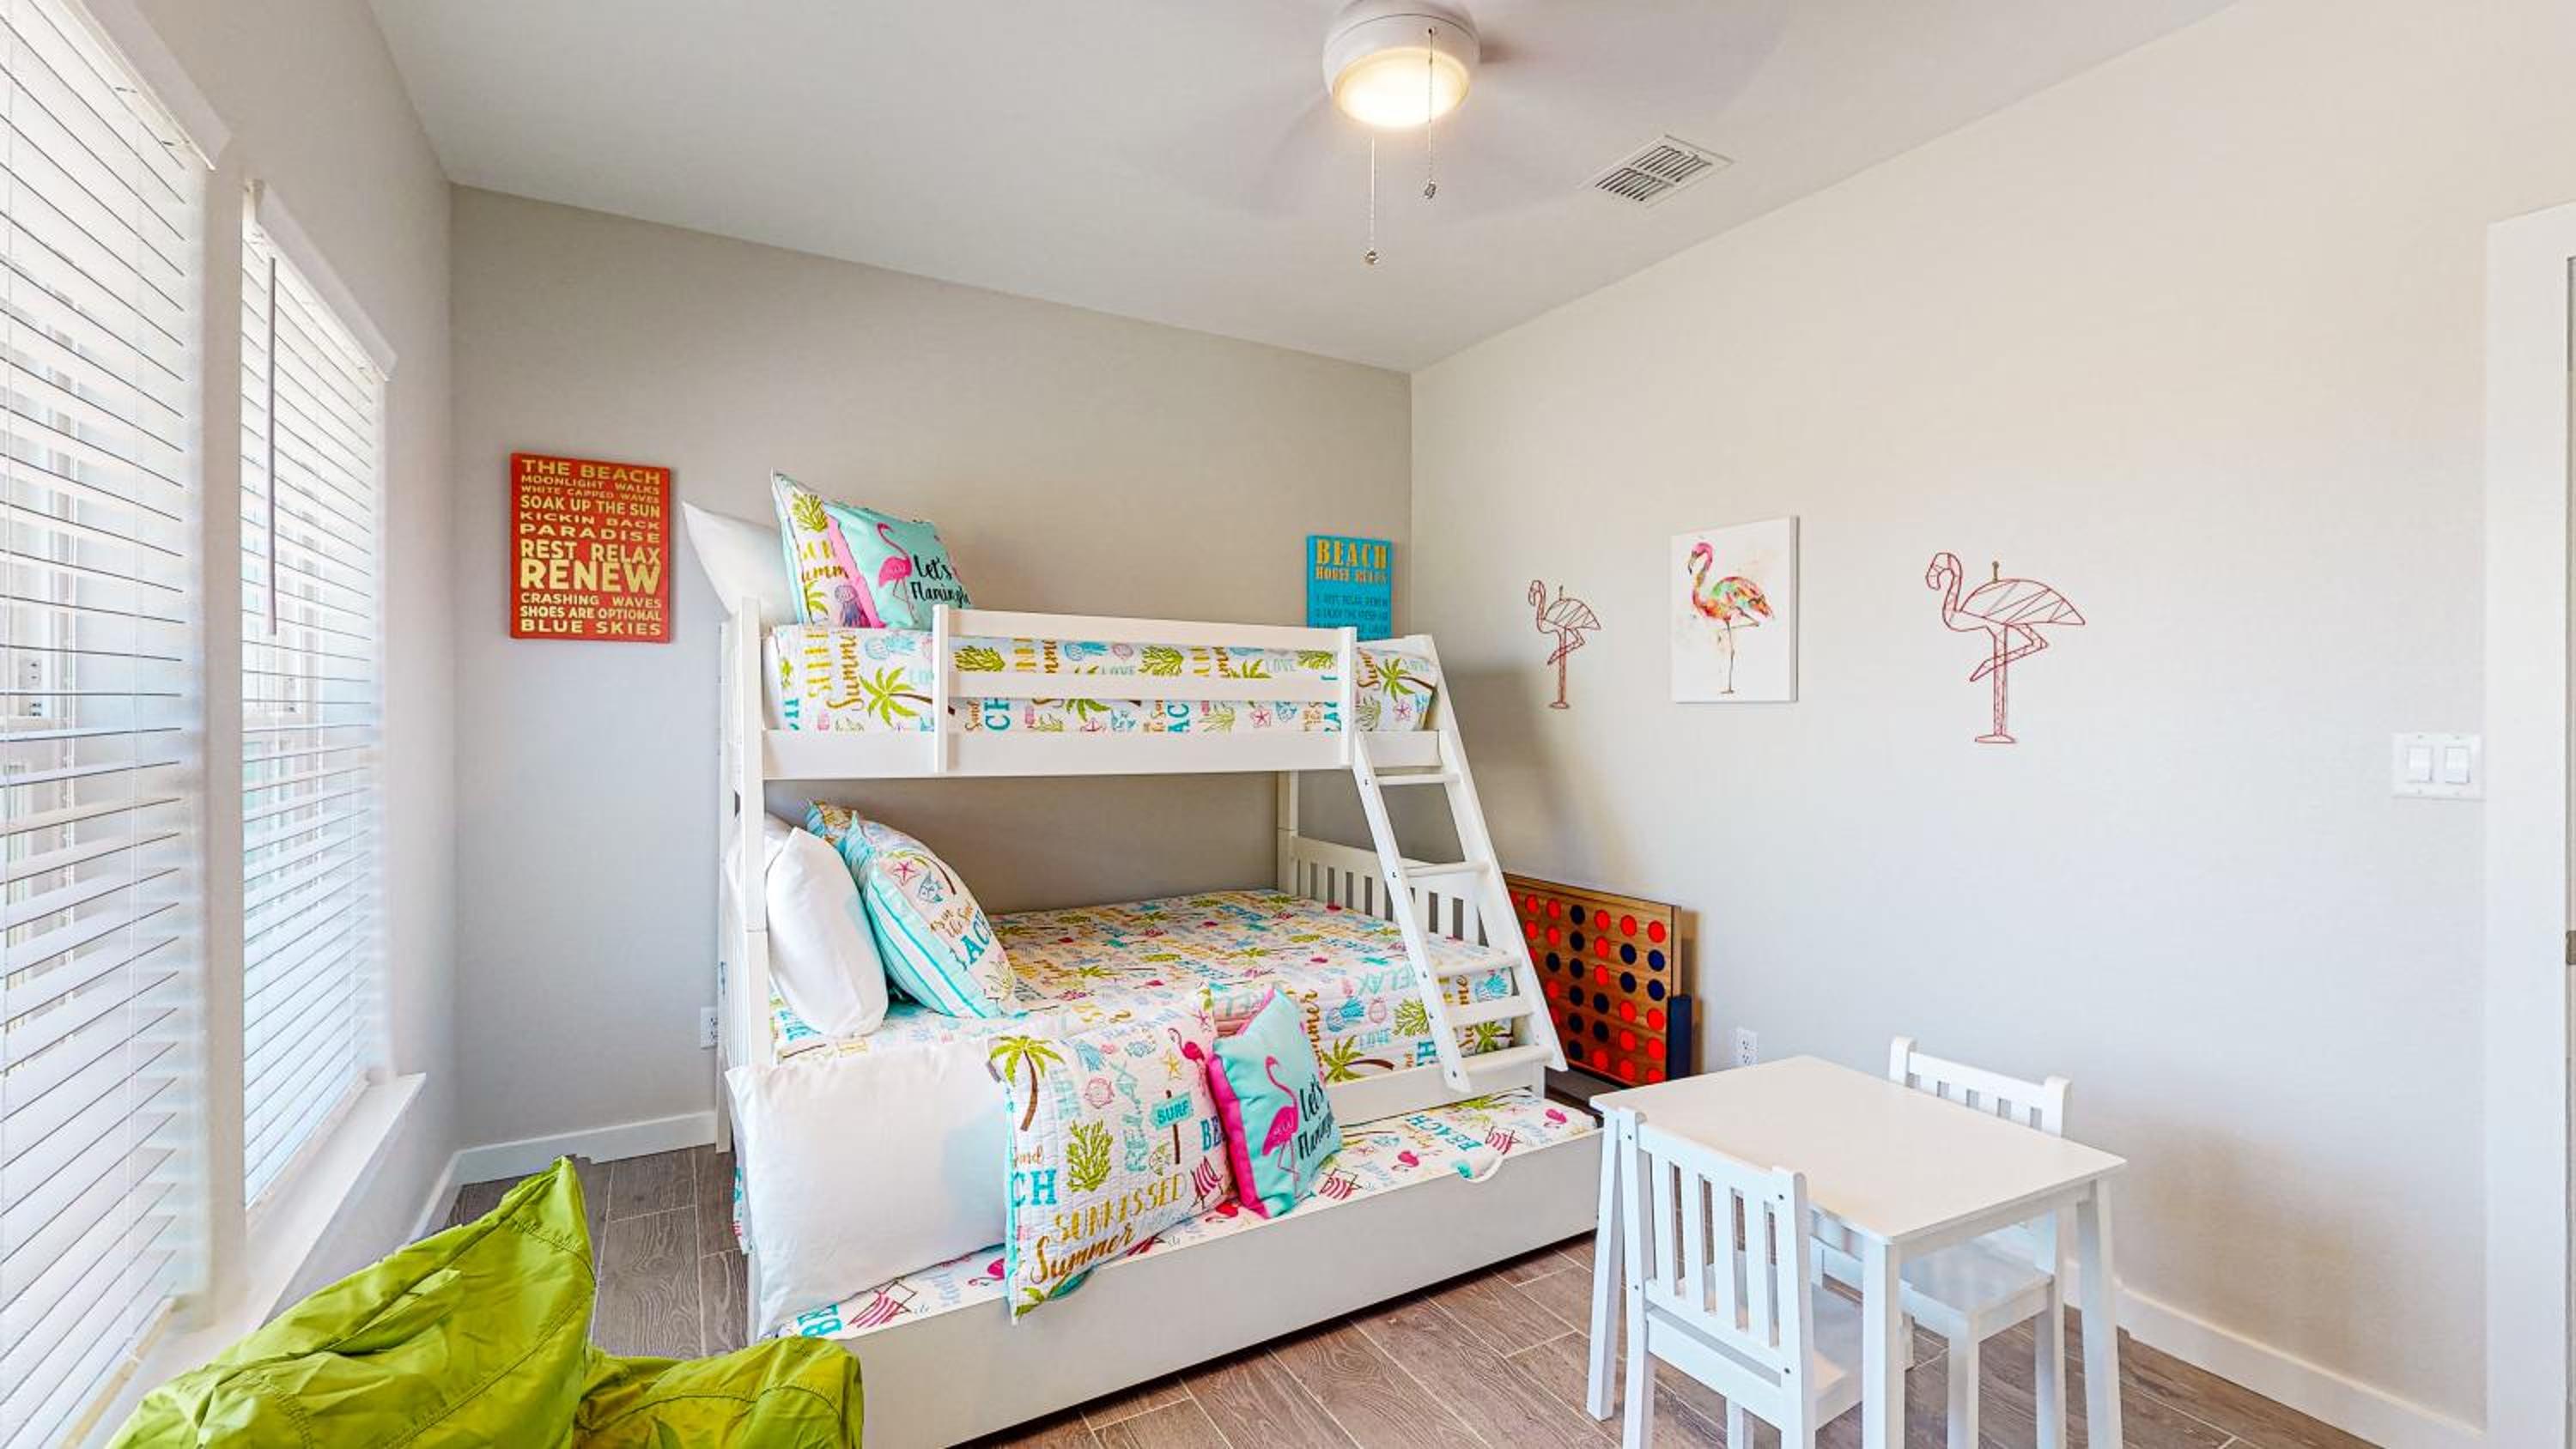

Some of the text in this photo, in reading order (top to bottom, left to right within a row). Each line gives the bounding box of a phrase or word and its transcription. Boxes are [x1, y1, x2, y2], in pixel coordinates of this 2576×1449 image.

[522, 459, 660, 485] THE BEACH
[521, 475, 659, 495] MOONLIGHT WALKS
[521, 485, 659, 504] WHITE CAPPED WAVES
[520, 494, 660, 518] SOAK UP THE SUN
[519, 523, 660, 543] PARADISE
[520, 512, 660, 530] KICKIN BACK
[520, 538, 660, 564] REST RELAX
[1317, 539, 1387, 569] BEACH
[519, 559, 661, 595] RENEW
[913, 555, 952, 580] Let's
[520, 592, 661, 609] CRASHING WAVES
[519, 605, 662, 621] SHOES ARE OPTIONAL
[521, 619, 661, 635] BLUE SKIES
[1157, 1100, 1189, 1125] SURF
[1030, 1222, 1134, 1285] Summer
